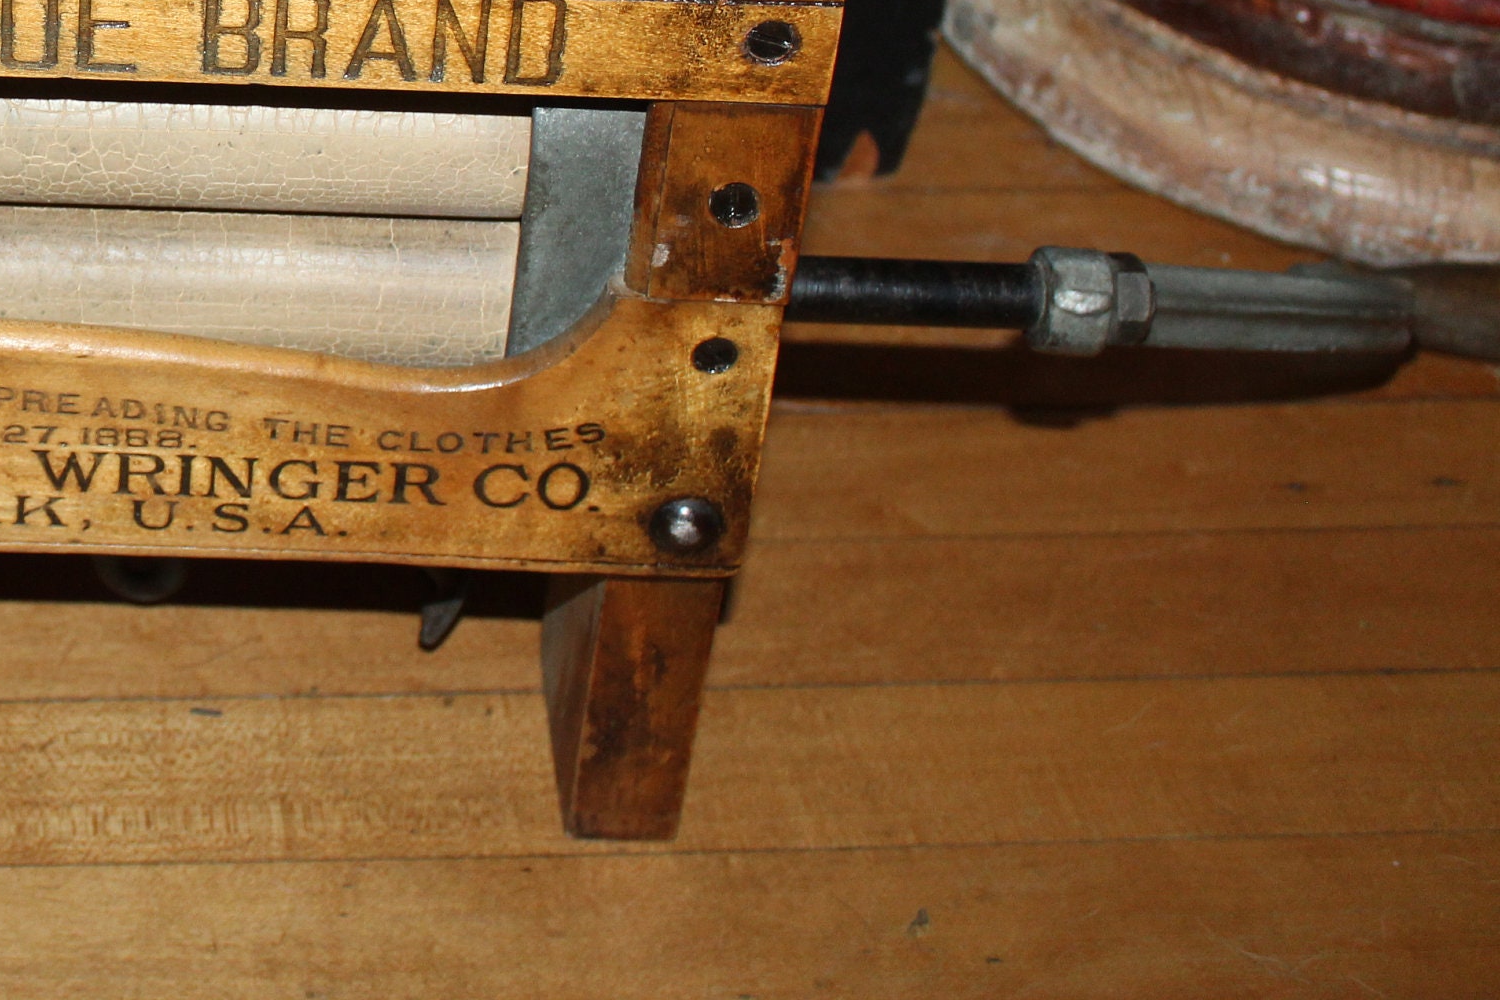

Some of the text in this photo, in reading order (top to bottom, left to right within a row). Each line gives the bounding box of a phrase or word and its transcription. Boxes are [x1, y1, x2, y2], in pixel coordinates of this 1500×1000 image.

[263, 416, 353, 448] THE
[377, 421, 607, 455] CLOTHES
[31, 448, 447, 506] WRINGER
[473, 460, 600, 513] CO.
[131, 500, 349, 537] U.S.A.
